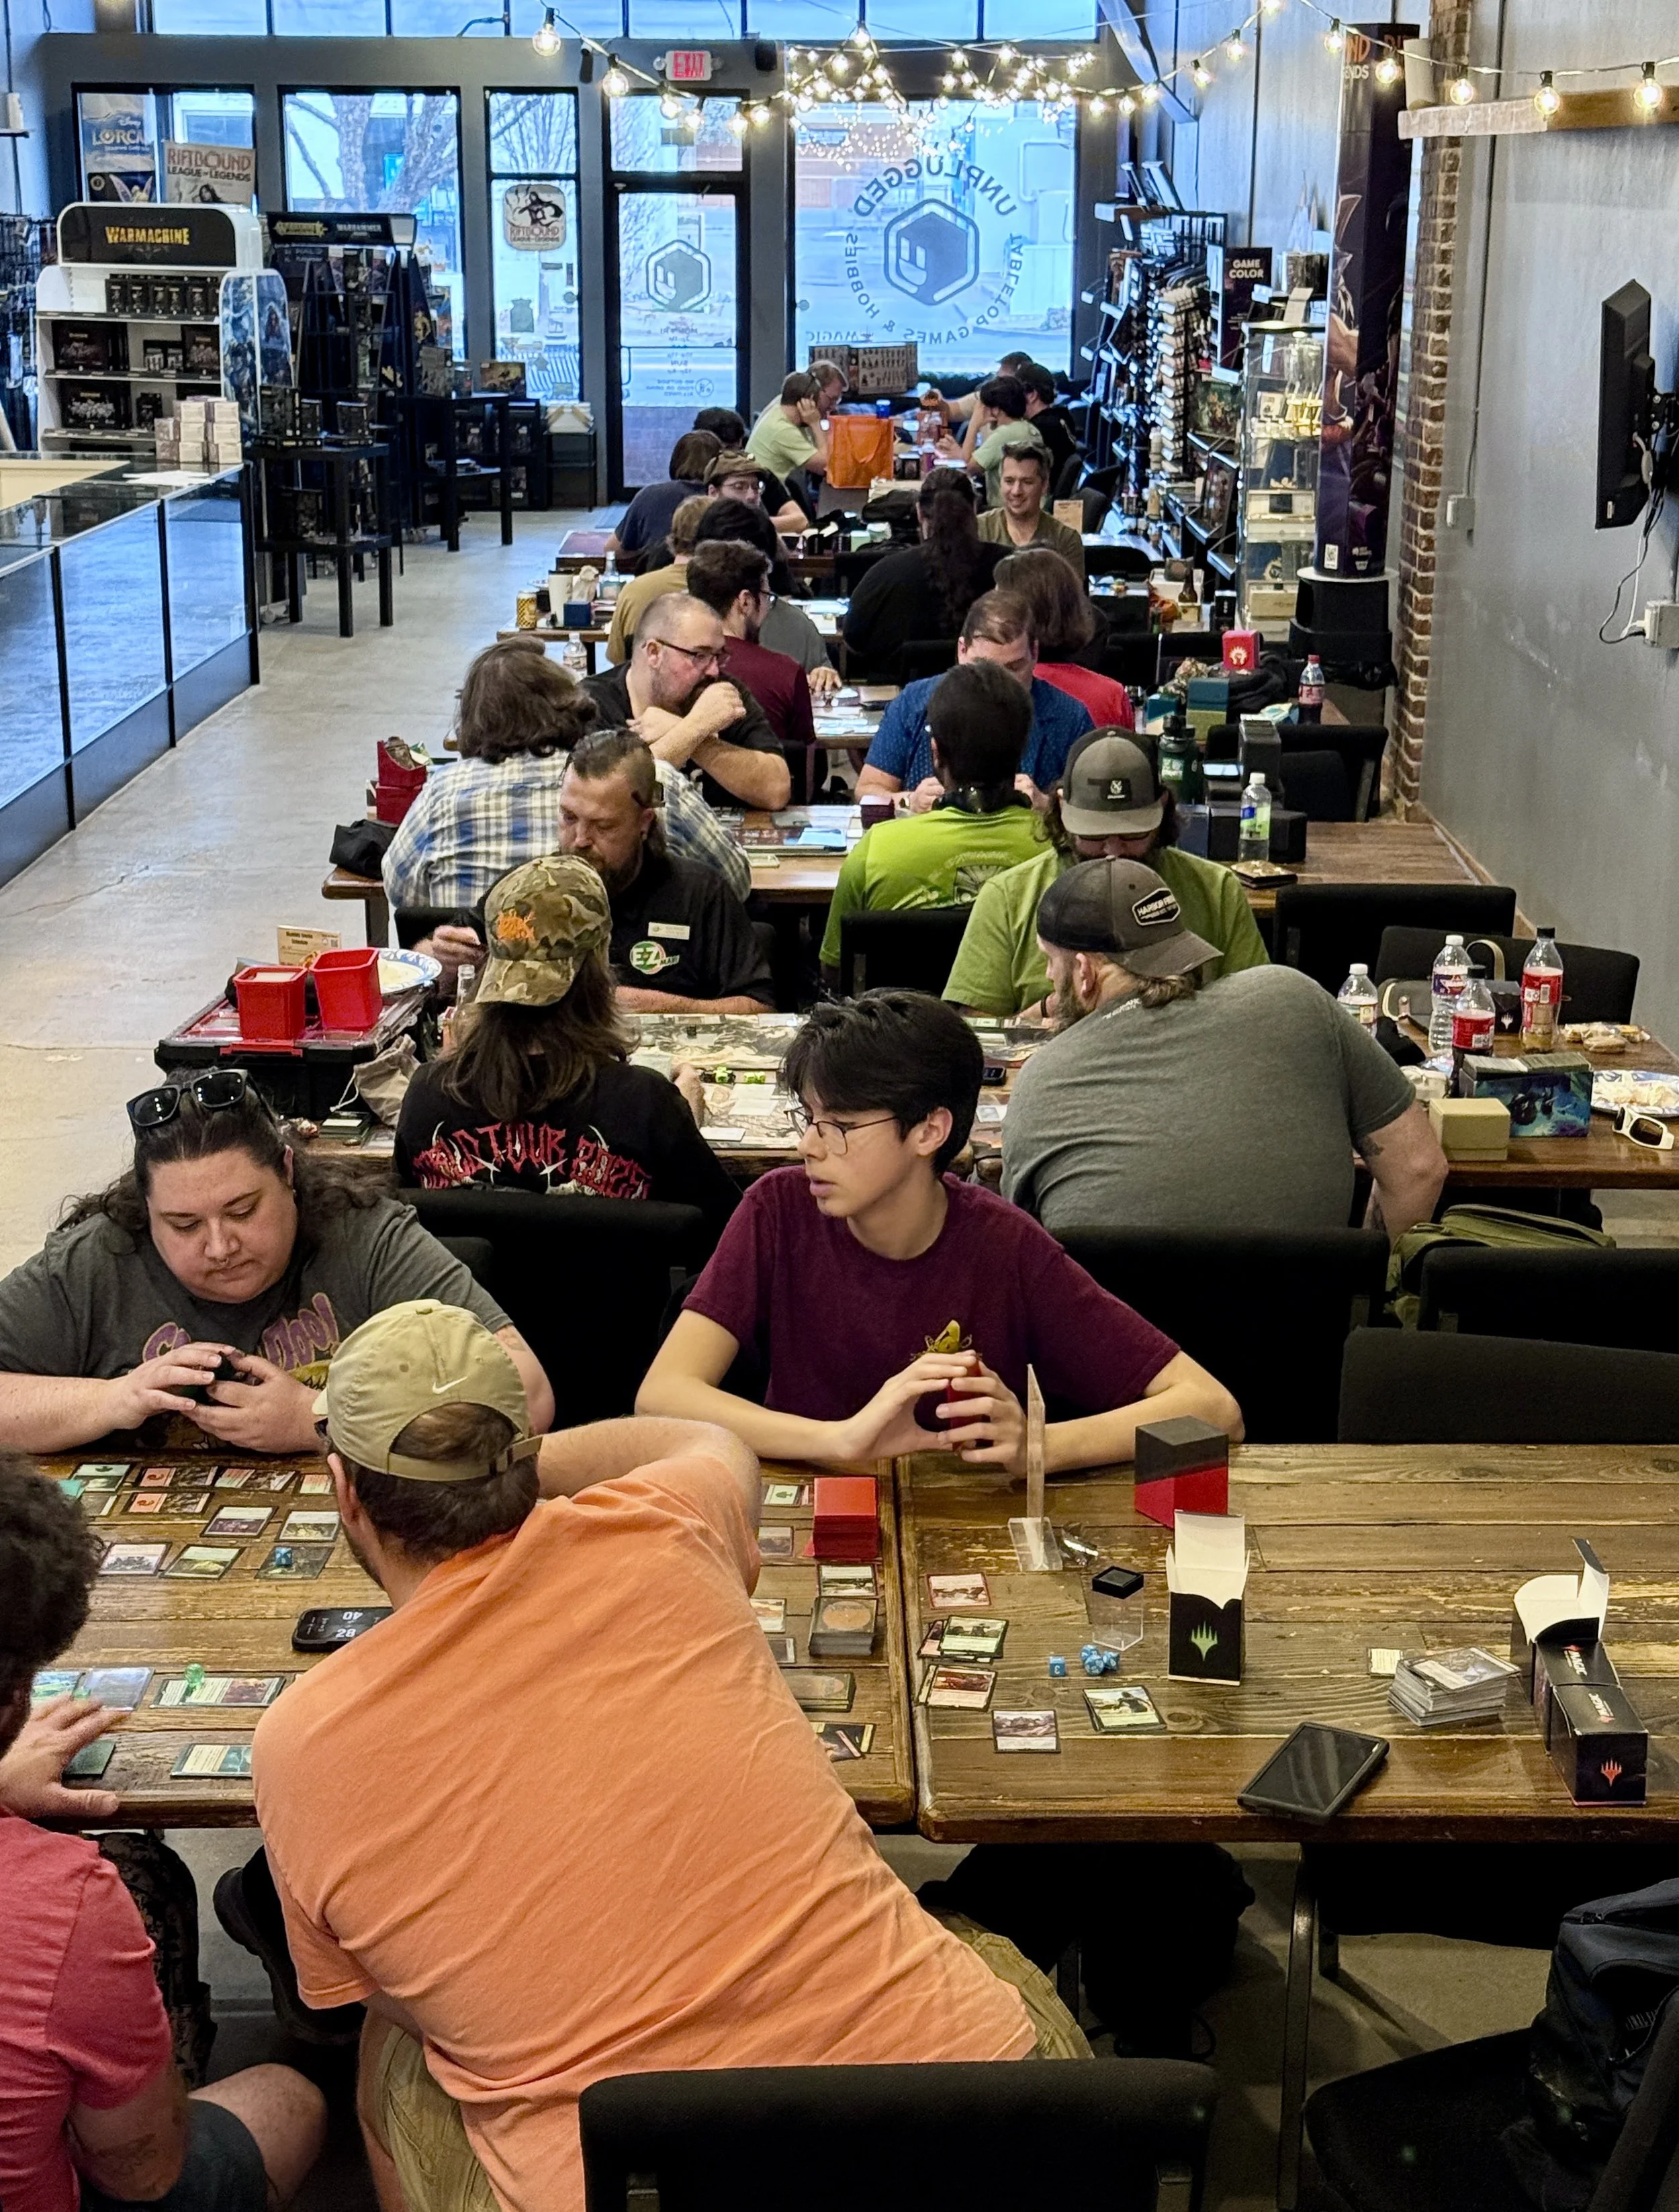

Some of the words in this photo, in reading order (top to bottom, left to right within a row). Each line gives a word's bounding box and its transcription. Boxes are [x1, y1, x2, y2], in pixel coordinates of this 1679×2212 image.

[674, 51, 704, 79] EXIT
[167, 148, 252, 172] RIFTBOUND
[167, 166, 202, 177] LEAGUE
[209, 169, 252, 182] LEGENDS
[105, 226, 191, 245] WARMACHINE
[1232, 259, 1261, 269] GAME
[1228, 269, 1264, 279] COLOR
[1136, 899, 1165, 917] HARBOR
[475, 1121, 568, 1175] TOUR
[343, 1612, 363, 1620] 40
[336, 1628, 357, 1638] 28
[1568, 1650, 1588, 1676] MAGIC
[1588, 1693, 1610, 1716] MAGIC
